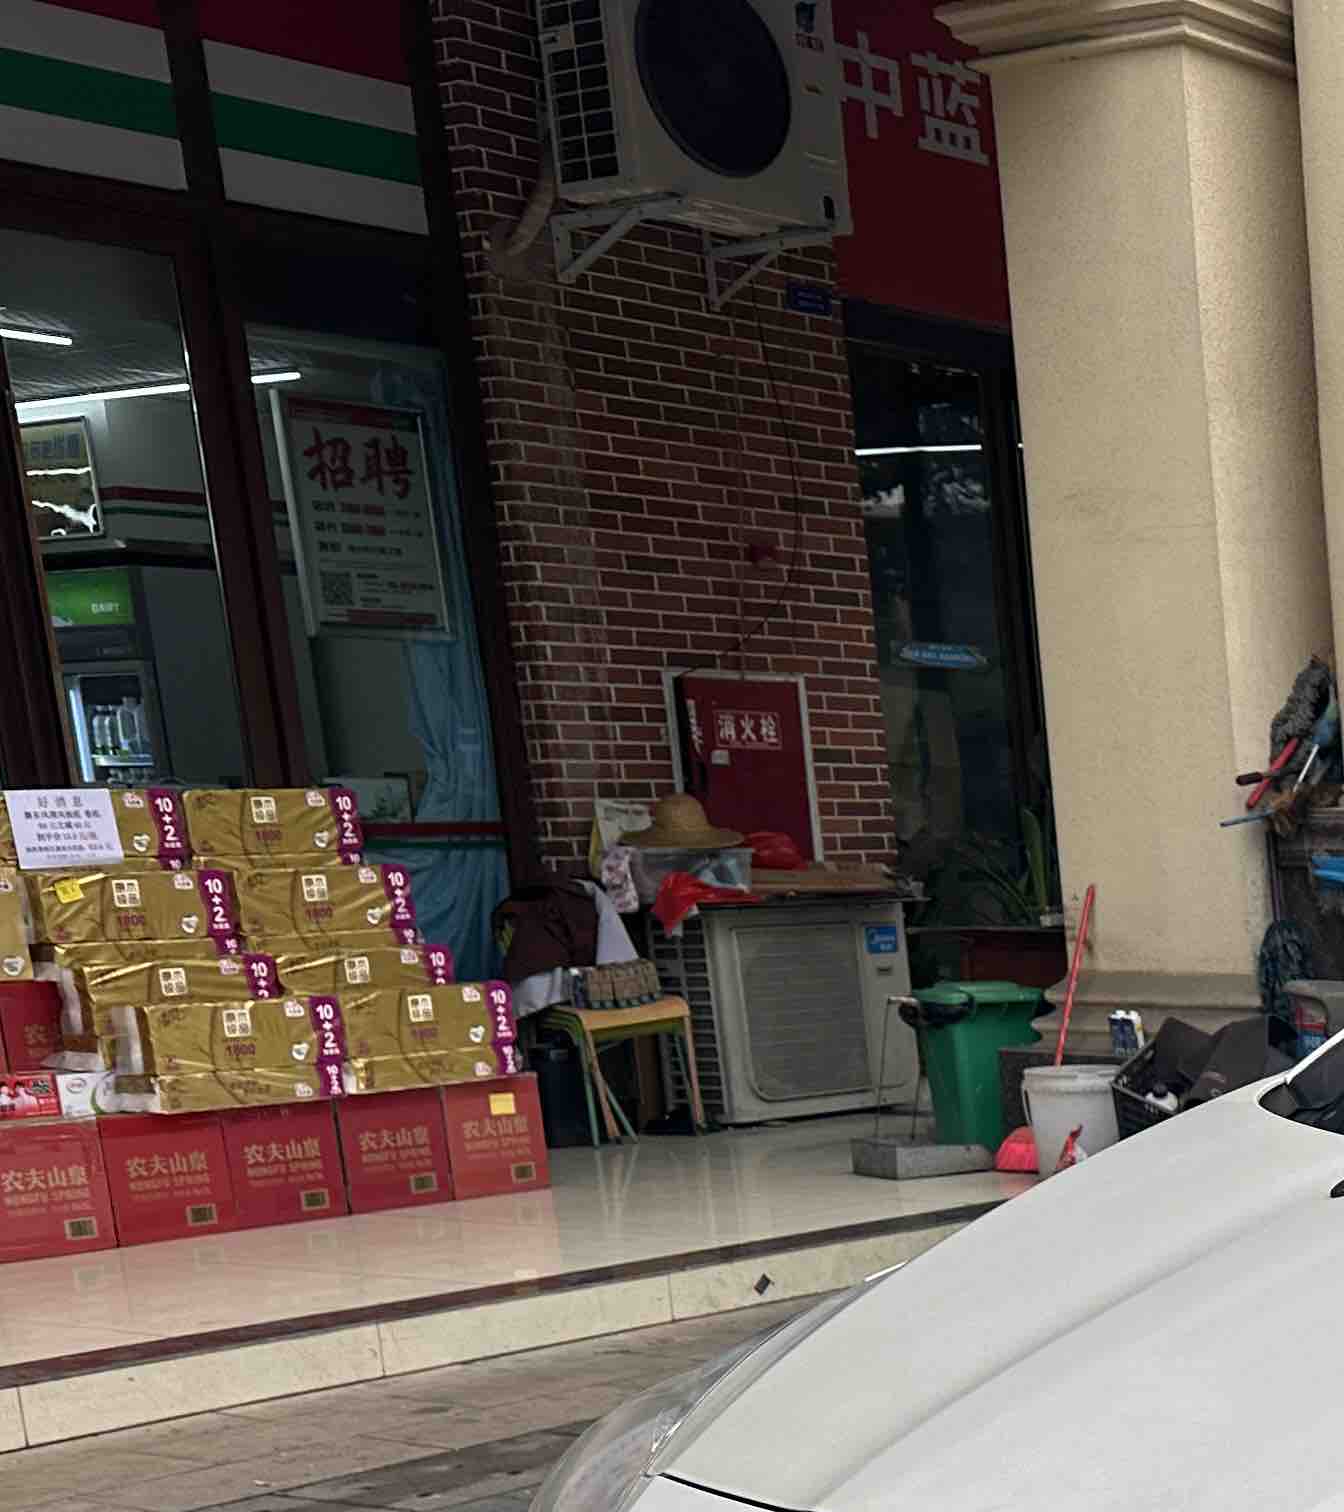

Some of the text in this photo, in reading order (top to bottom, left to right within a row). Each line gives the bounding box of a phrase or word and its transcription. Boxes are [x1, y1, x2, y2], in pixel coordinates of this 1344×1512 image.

[836, 30, 990, 166] 中蓝
[303, 426, 415, 499] 招聘
[718, 713, 779, 743] 消火栓
[244, 1136, 321, 1164] 农夫山泉
[359, 1126, 430, 1150] 农夫山泉
[126, 1150, 208, 1178] 农夫山泉
[1, 1166, 89, 1192] 农夫山泉
